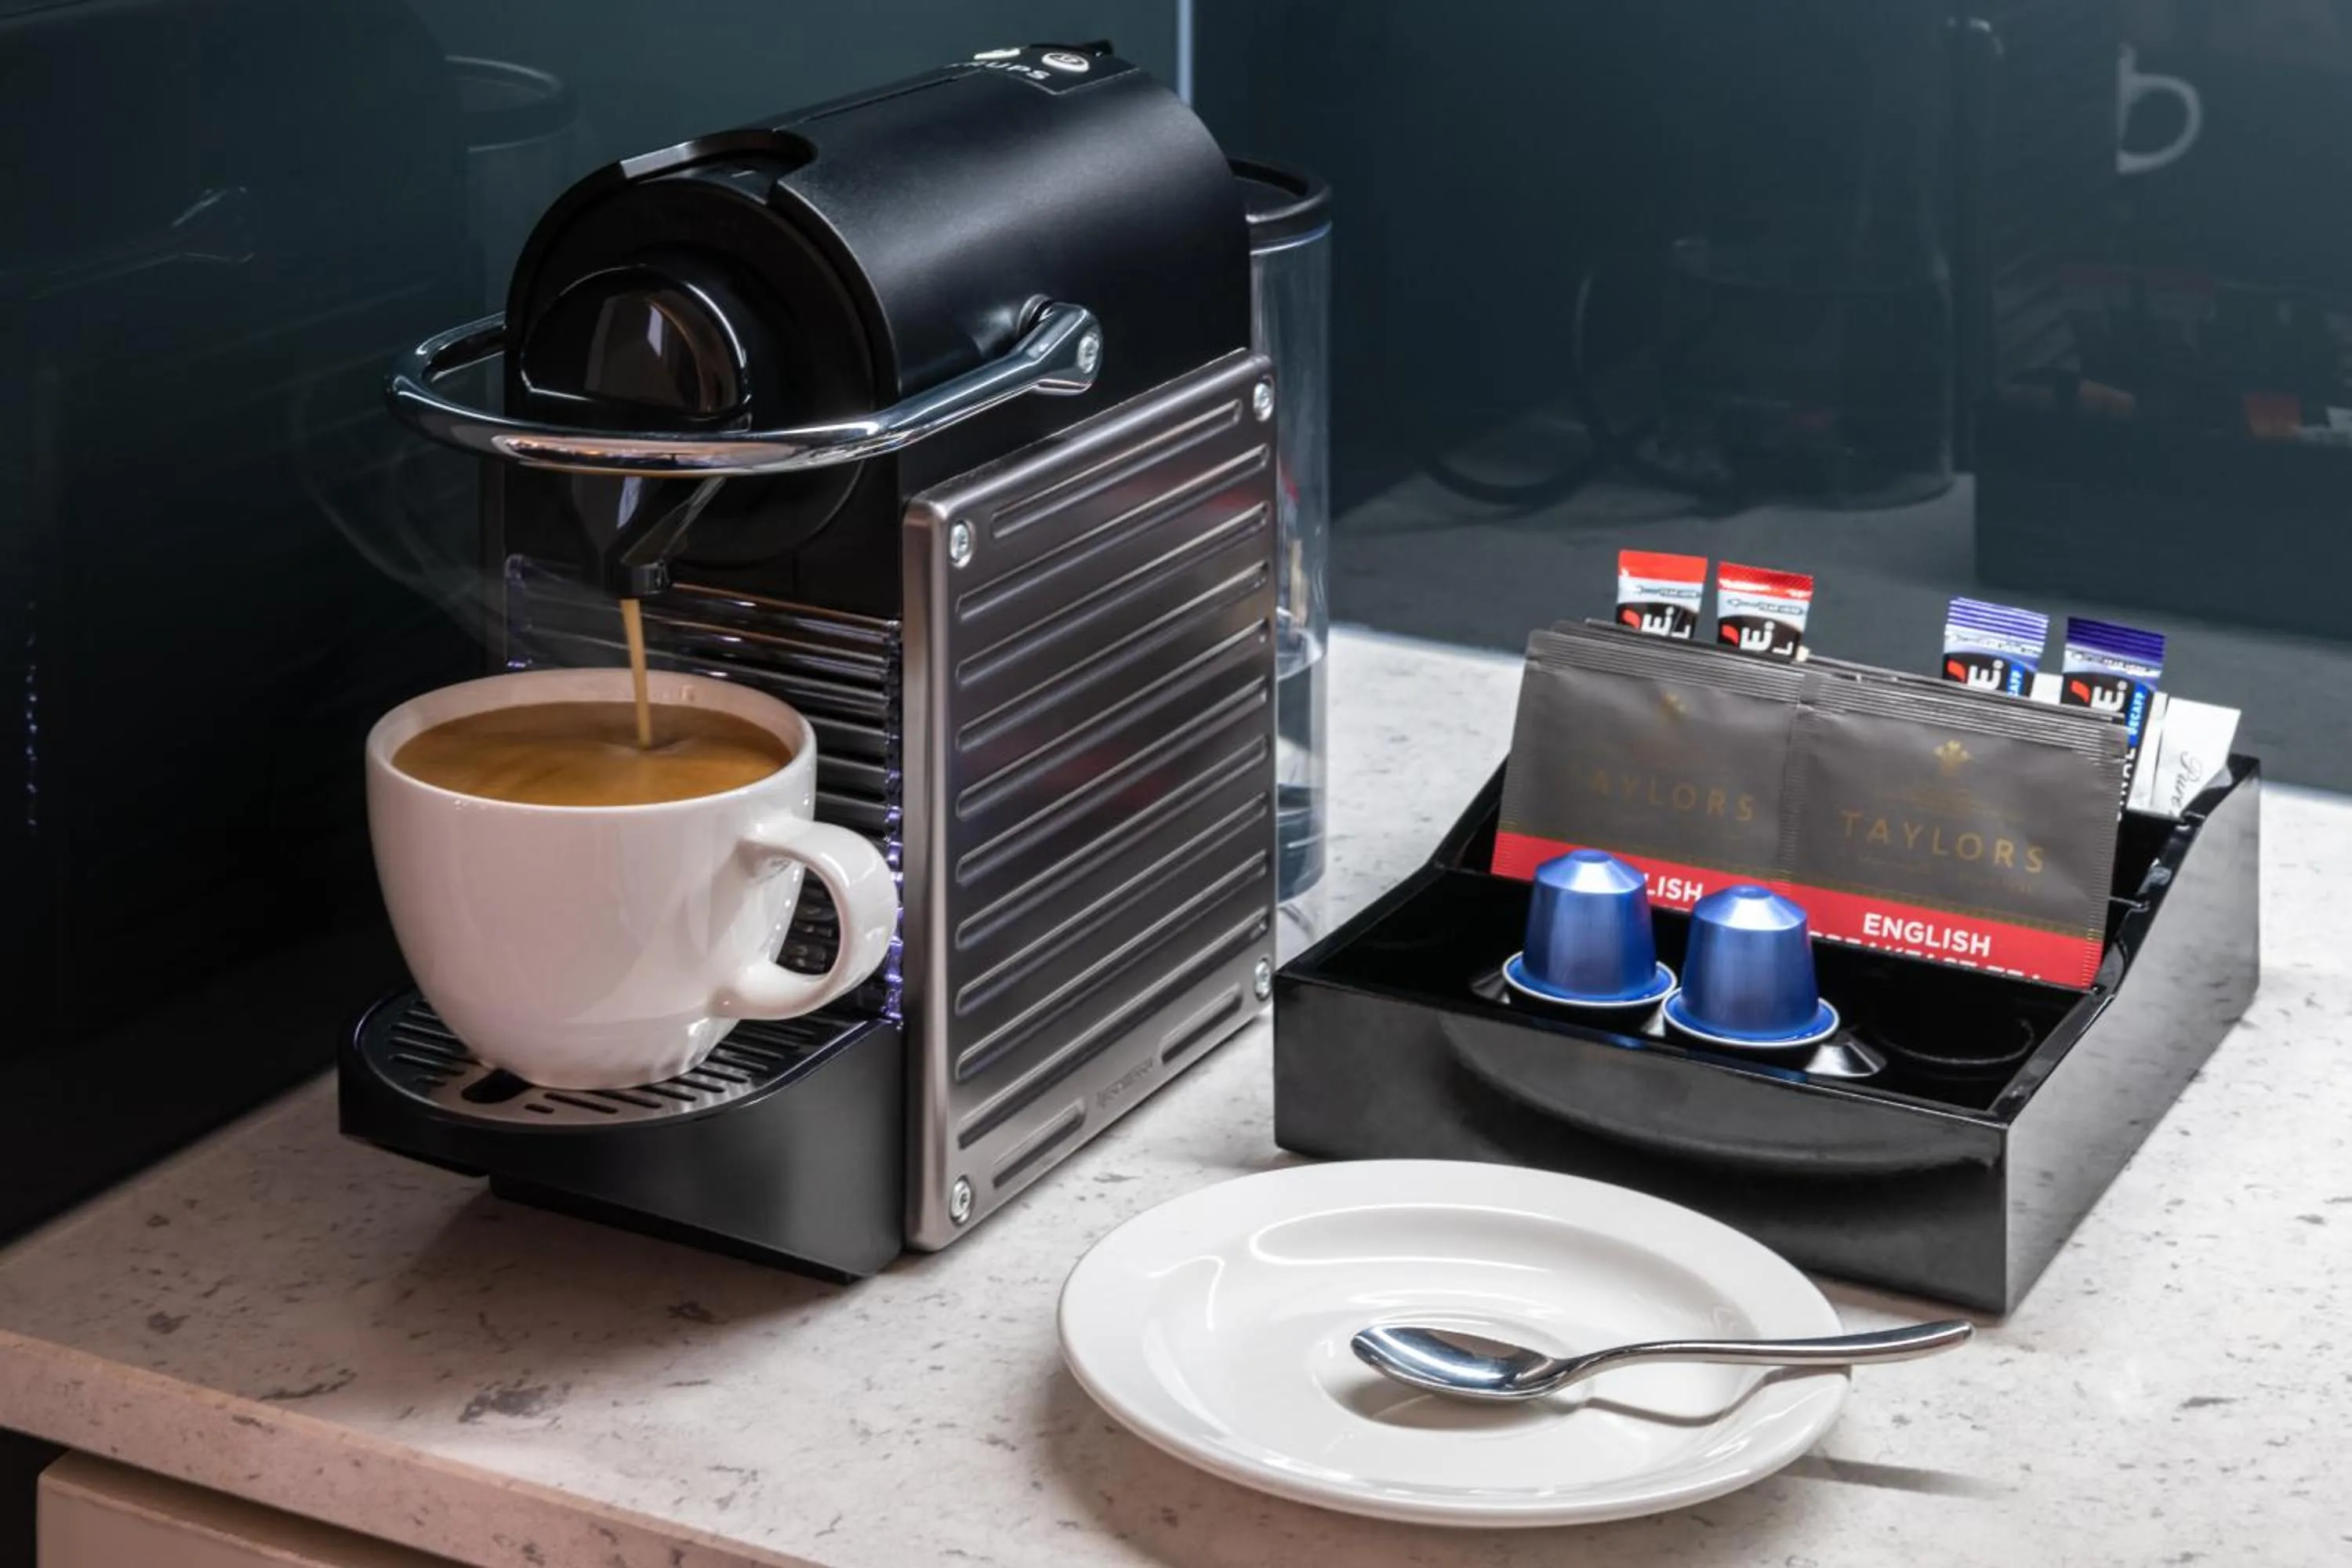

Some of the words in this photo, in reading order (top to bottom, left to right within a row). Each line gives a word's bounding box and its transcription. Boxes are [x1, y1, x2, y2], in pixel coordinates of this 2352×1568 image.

[1591, 769, 1755, 821] AYLORS
[1842, 810, 2044, 873] TAYLORS
[1643, 872, 1704, 902] LISH
[1863, 913, 1991, 957] ENGLISH
